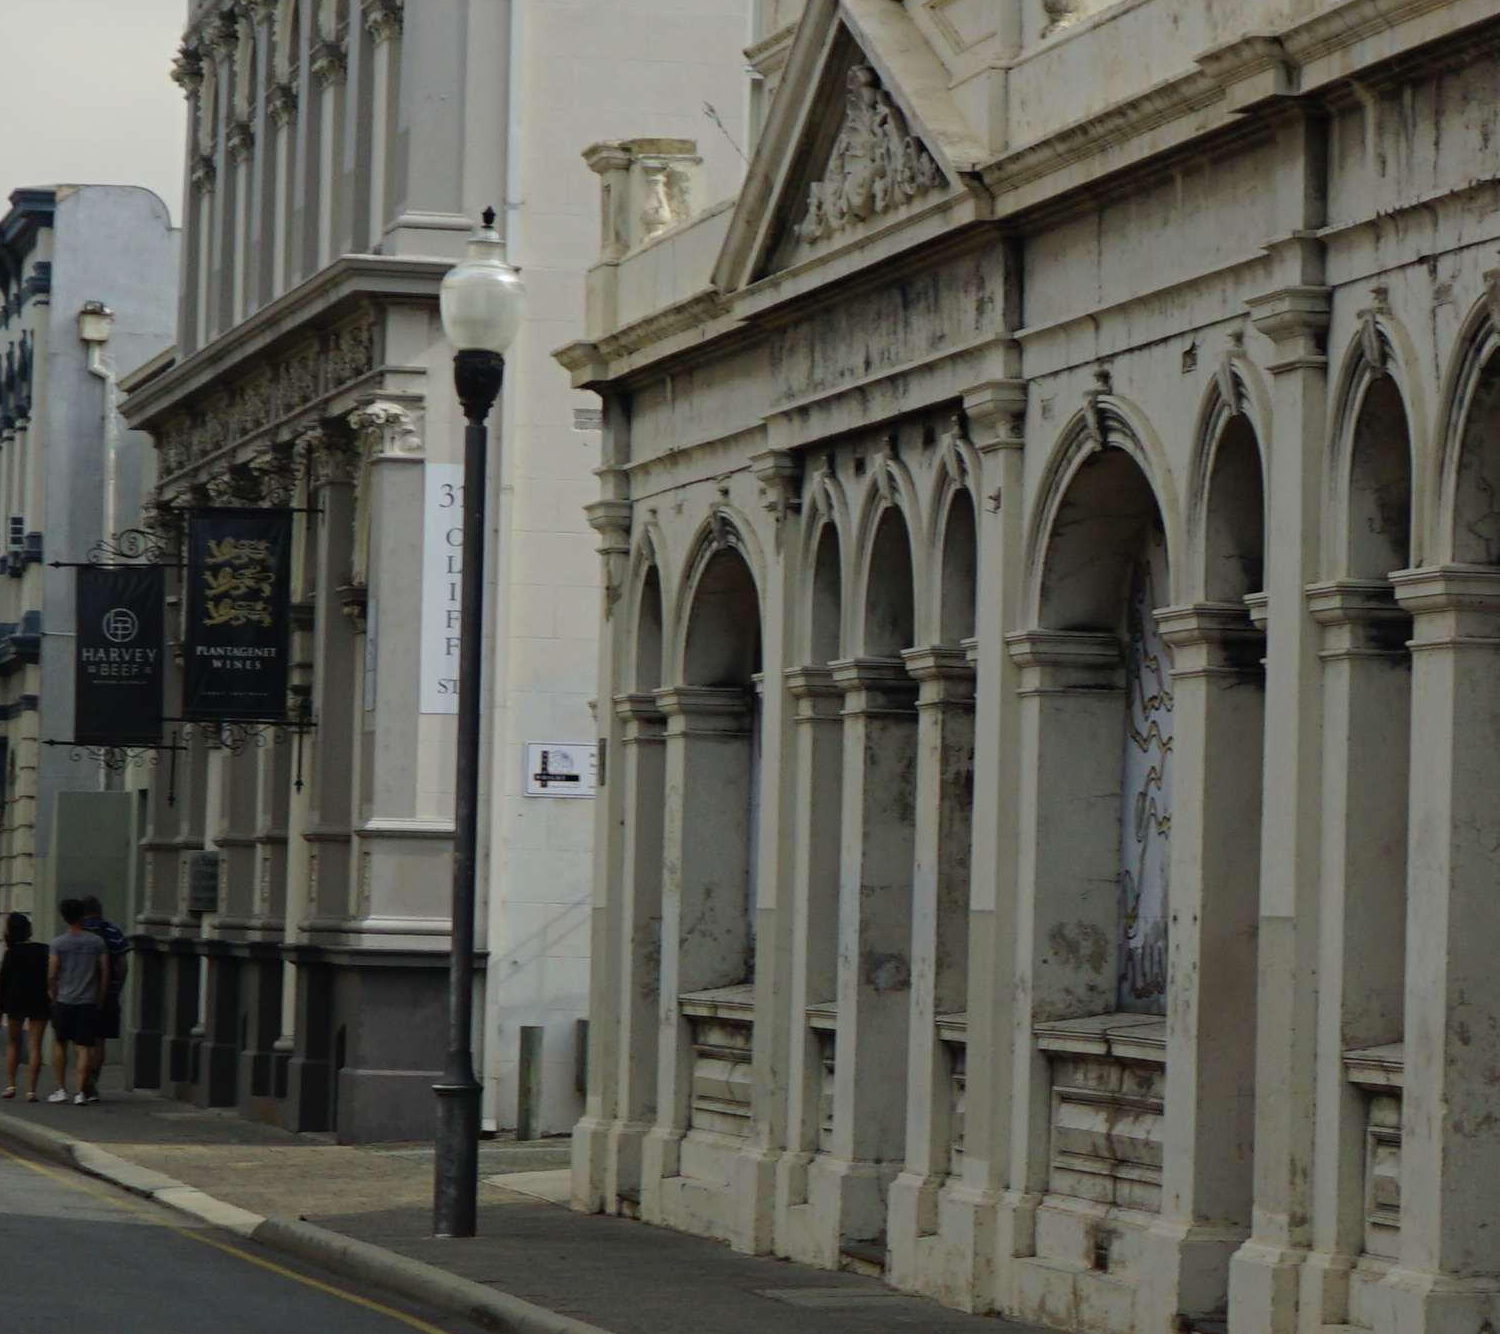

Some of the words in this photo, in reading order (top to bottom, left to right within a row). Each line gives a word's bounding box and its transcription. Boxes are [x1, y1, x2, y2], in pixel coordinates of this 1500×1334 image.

[445, 527, 464, 655] CLIFF
[81, 648, 157, 662] HARVEY
[195, 646, 276, 658] PLANTAGENET
[100, 664, 140, 676] BEEF
[212, 658, 261, 670] WINES
